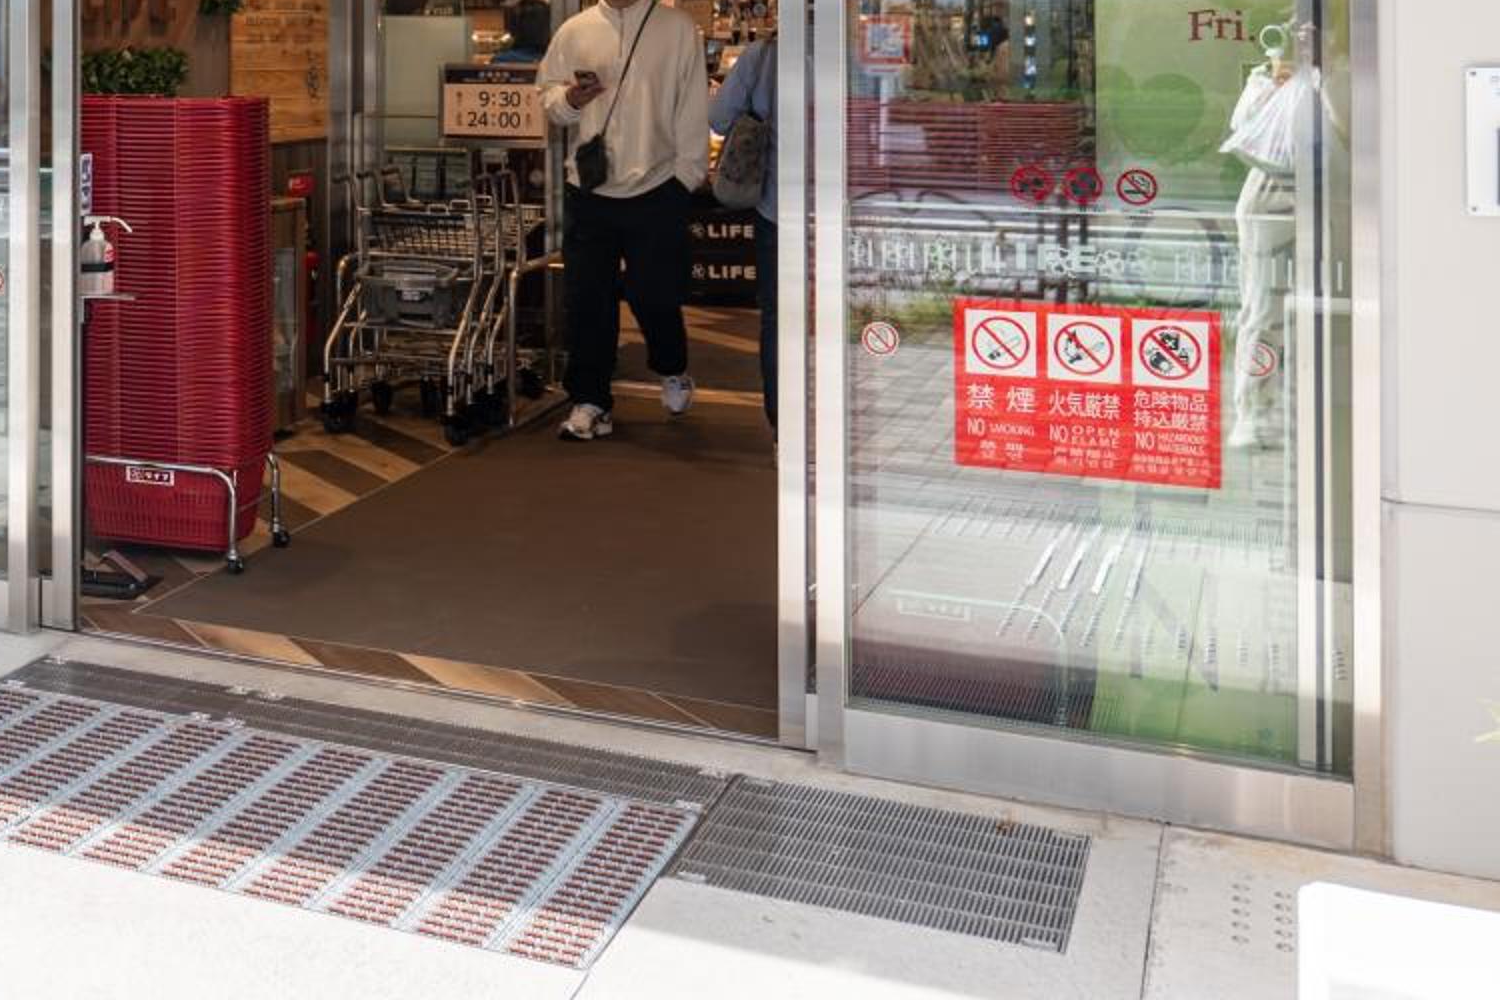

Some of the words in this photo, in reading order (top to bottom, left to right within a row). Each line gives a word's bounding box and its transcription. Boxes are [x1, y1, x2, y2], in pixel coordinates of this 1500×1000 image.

[1188, 9, 1256, 42] Fri.
[478, 91, 521, 108] 9:30
[467, 111, 521, 129] 24:00
[707, 224, 755, 238] LIFE
[707, 265, 757, 279] LIFE
[966, 383, 1037, 413] 禁煙
[1048, 389, 1121, 420] 火気厳禁
[966, 417, 986, 438] NO
[1049, 424, 1069, 443] NO
[1071, 425, 1121, 439] OPEN
[1135, 432, 1156, 451] NO
